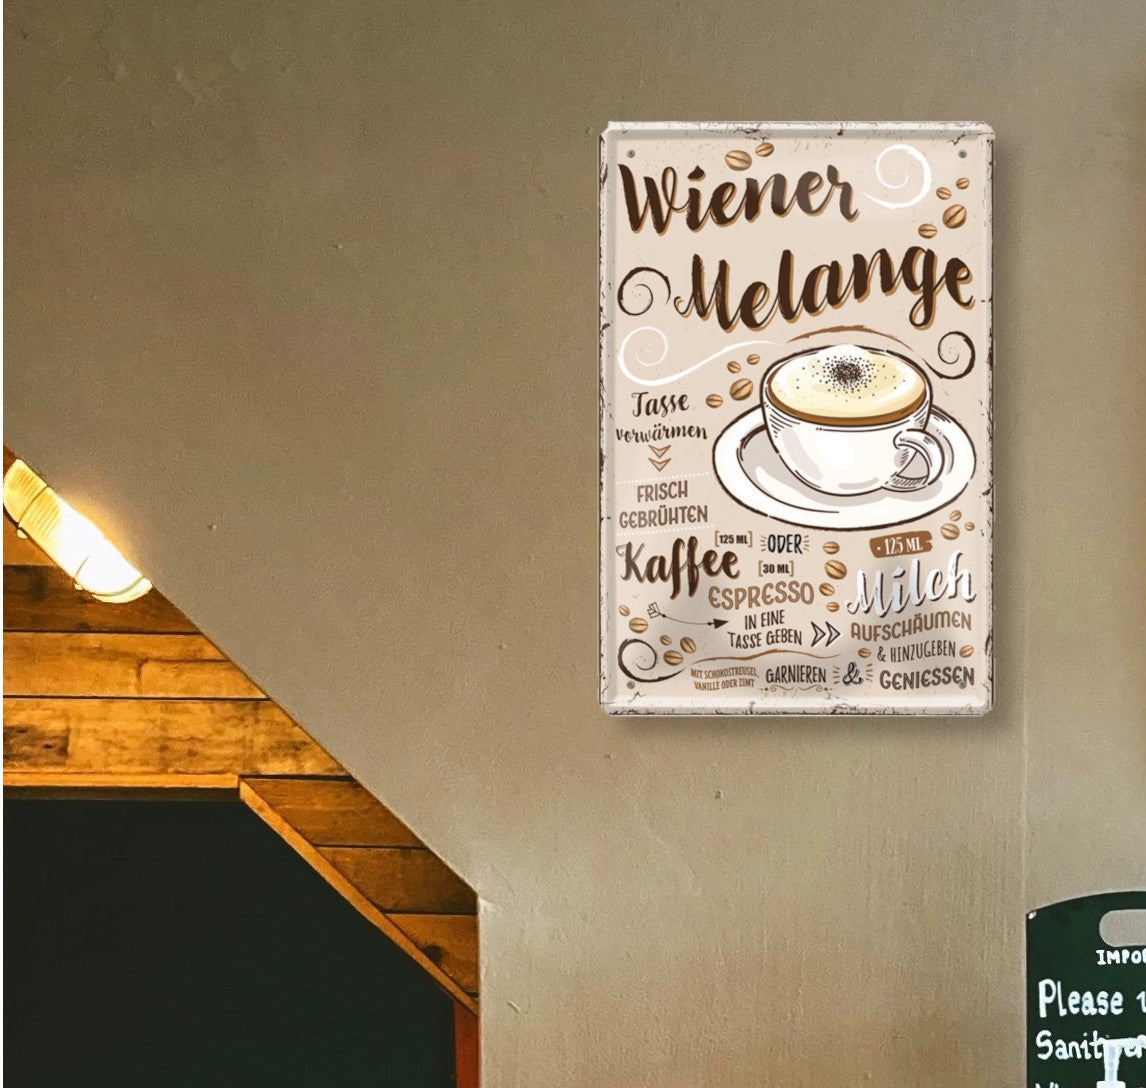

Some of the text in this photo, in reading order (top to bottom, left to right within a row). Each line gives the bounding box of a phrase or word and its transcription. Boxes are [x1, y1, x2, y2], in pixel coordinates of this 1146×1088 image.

[618, 164, 861, 235] Wiener
[673, 245, 975, 333] Melange
[631, 391, 691, 417] Tasse
[616, 423, 708, 443] vorwärmen
[637, 480, 688, 502] FRISCH
[619, 505, 709, 529] GEBRÜHTEN
[767, 533, 803, 554] ODER
[884, 537, 923, 556] 125 ML
[616, 535, 741, 600] Kaffee
[708, 580, 815, 610] ESPRESSO
[846, 550, 977, 618] Milch
[744, 609, 785, 630] IN EINE
[850, 610, 972, 642] AUFSCHÄUMEN
[727, 628, 802, 649] TASSE GEBEN
[877, 640, 956, 663] & HINZUGEBEN
[690, 667, 703, 678] MIT
[694, 677, 756, 691] VANILLE ODER ZIMT
[765, 661, 975, 690] GARNIEREN & GENIESSEN
[1038, 978, 1124, 1018] Please
